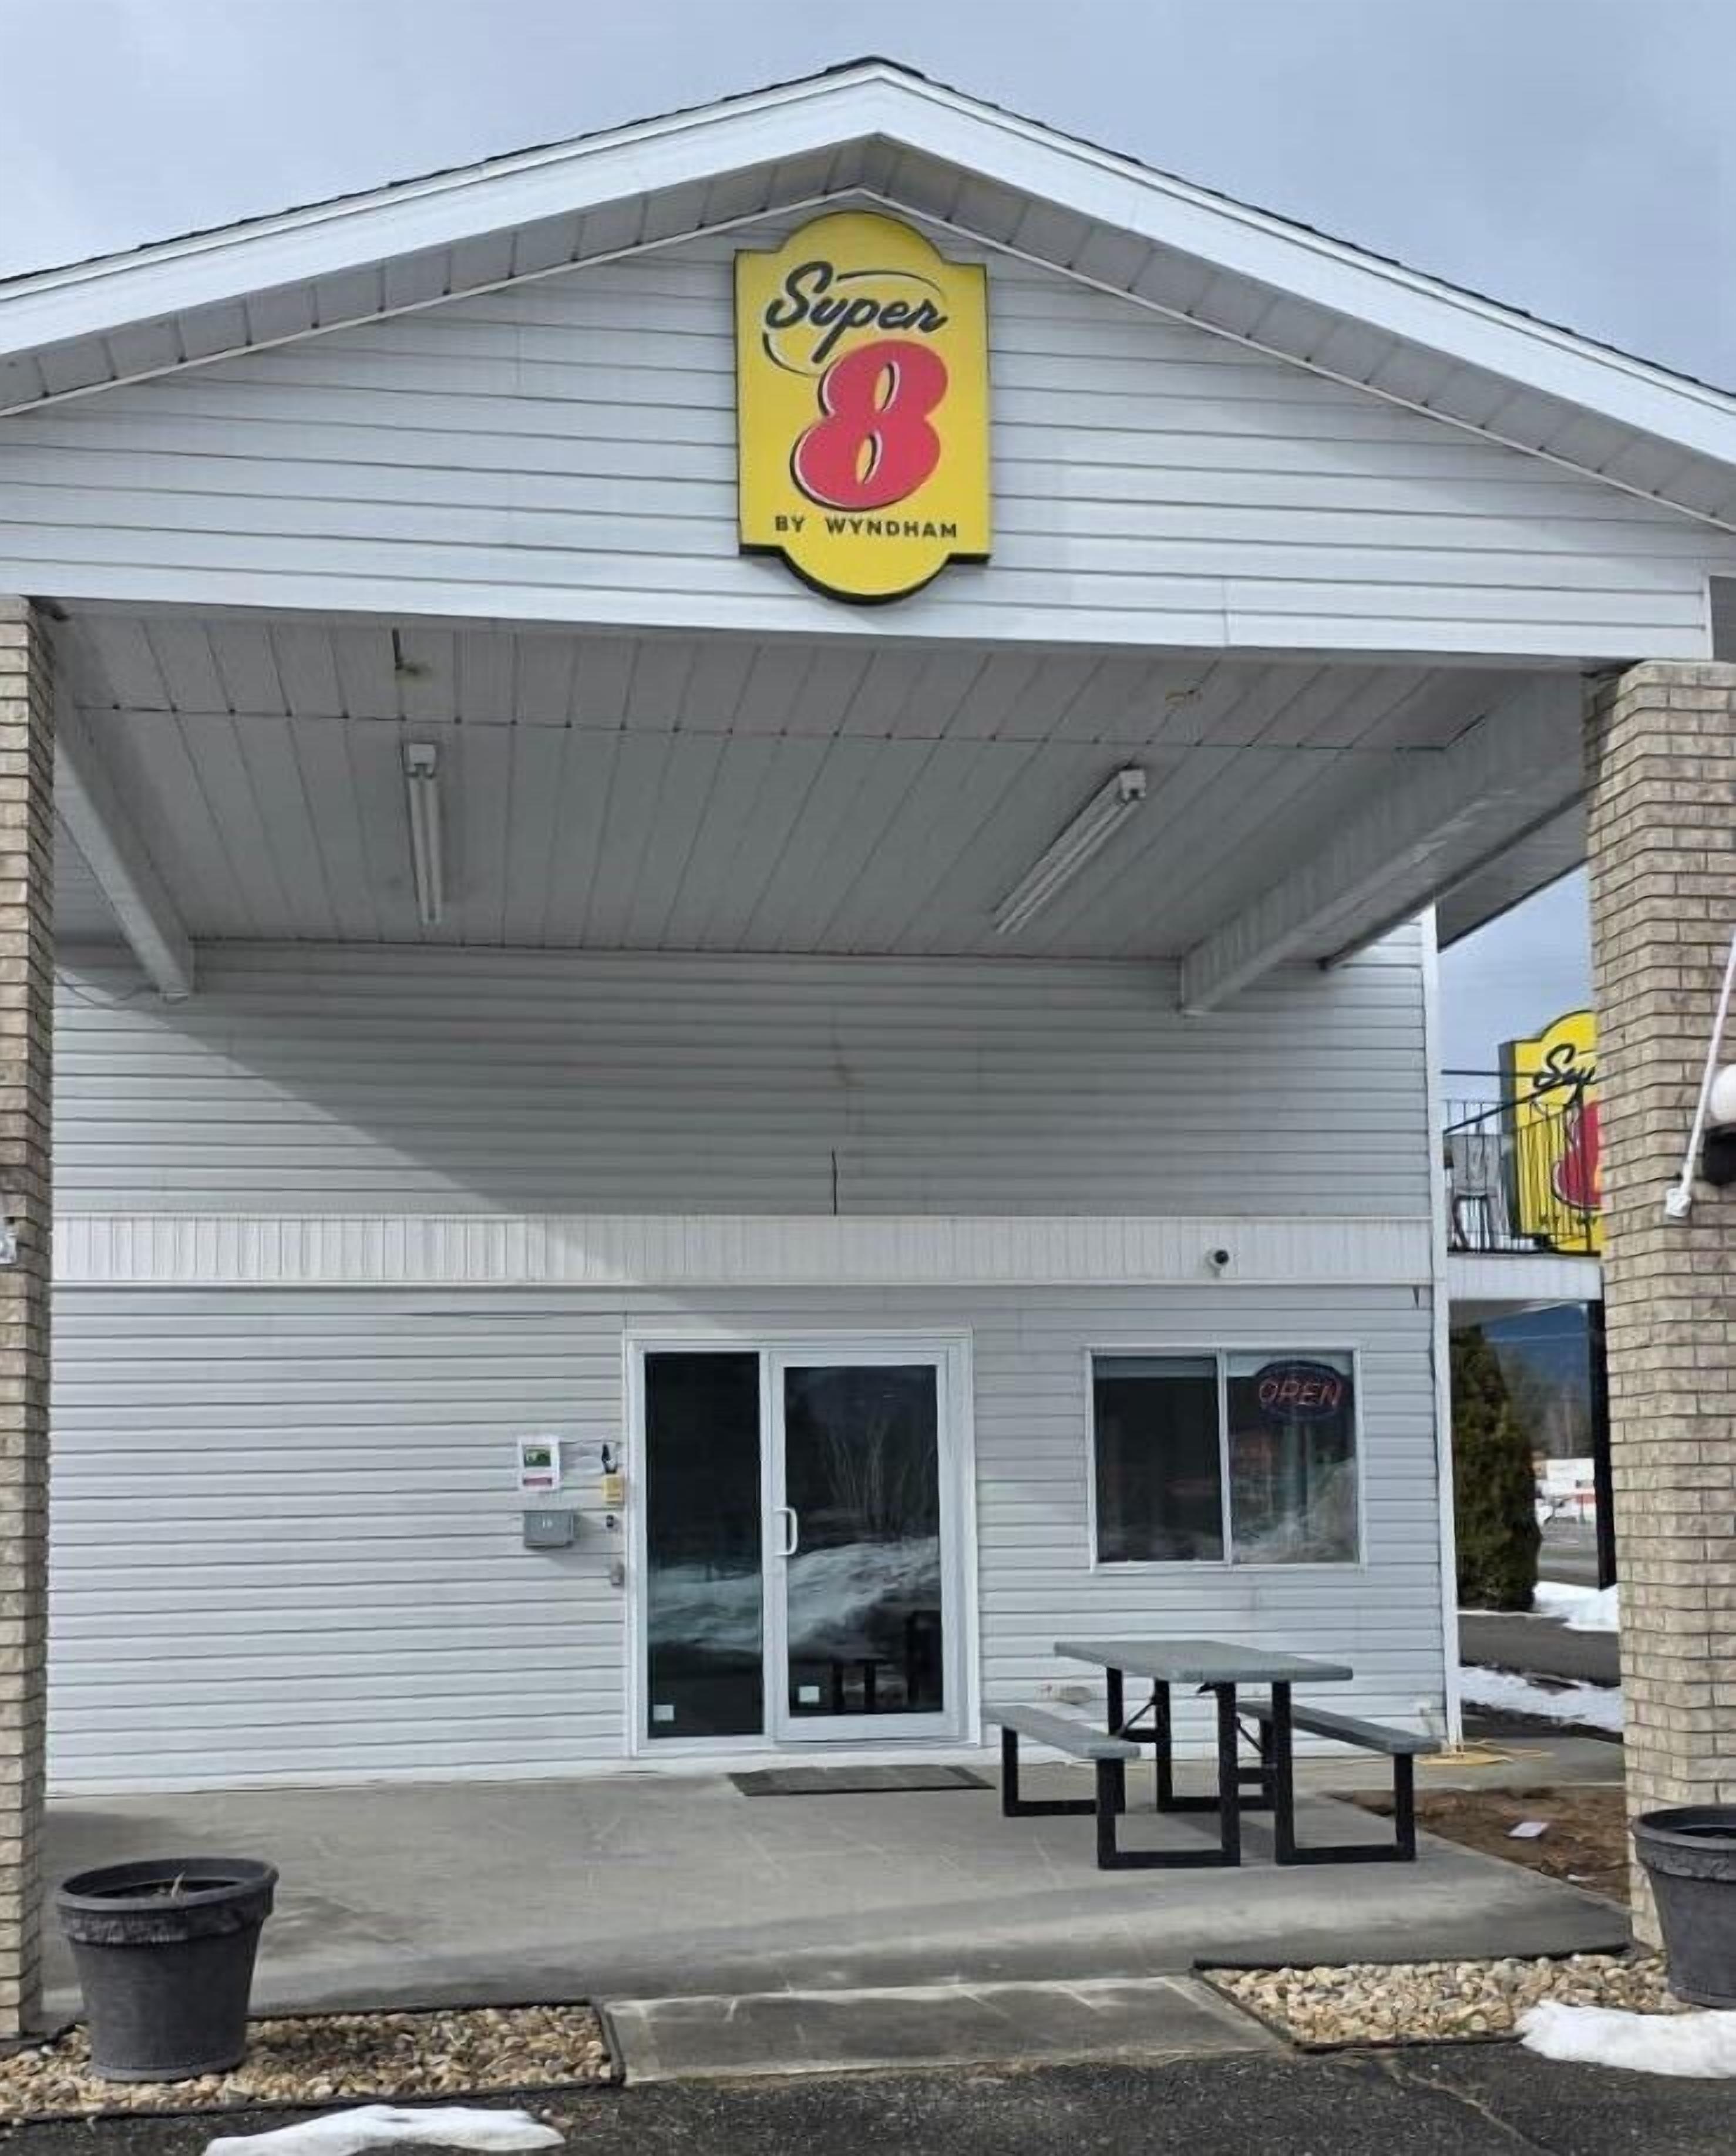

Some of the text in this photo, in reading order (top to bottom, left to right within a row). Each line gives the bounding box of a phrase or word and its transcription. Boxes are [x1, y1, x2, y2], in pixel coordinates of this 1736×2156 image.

[766, 261, 948, 363] Super
[790, 339, 948, 511] 8
[775, 516, 957, 537] BY WYNDHAM
[1259, 1380, 1342, 1406] OPEN
